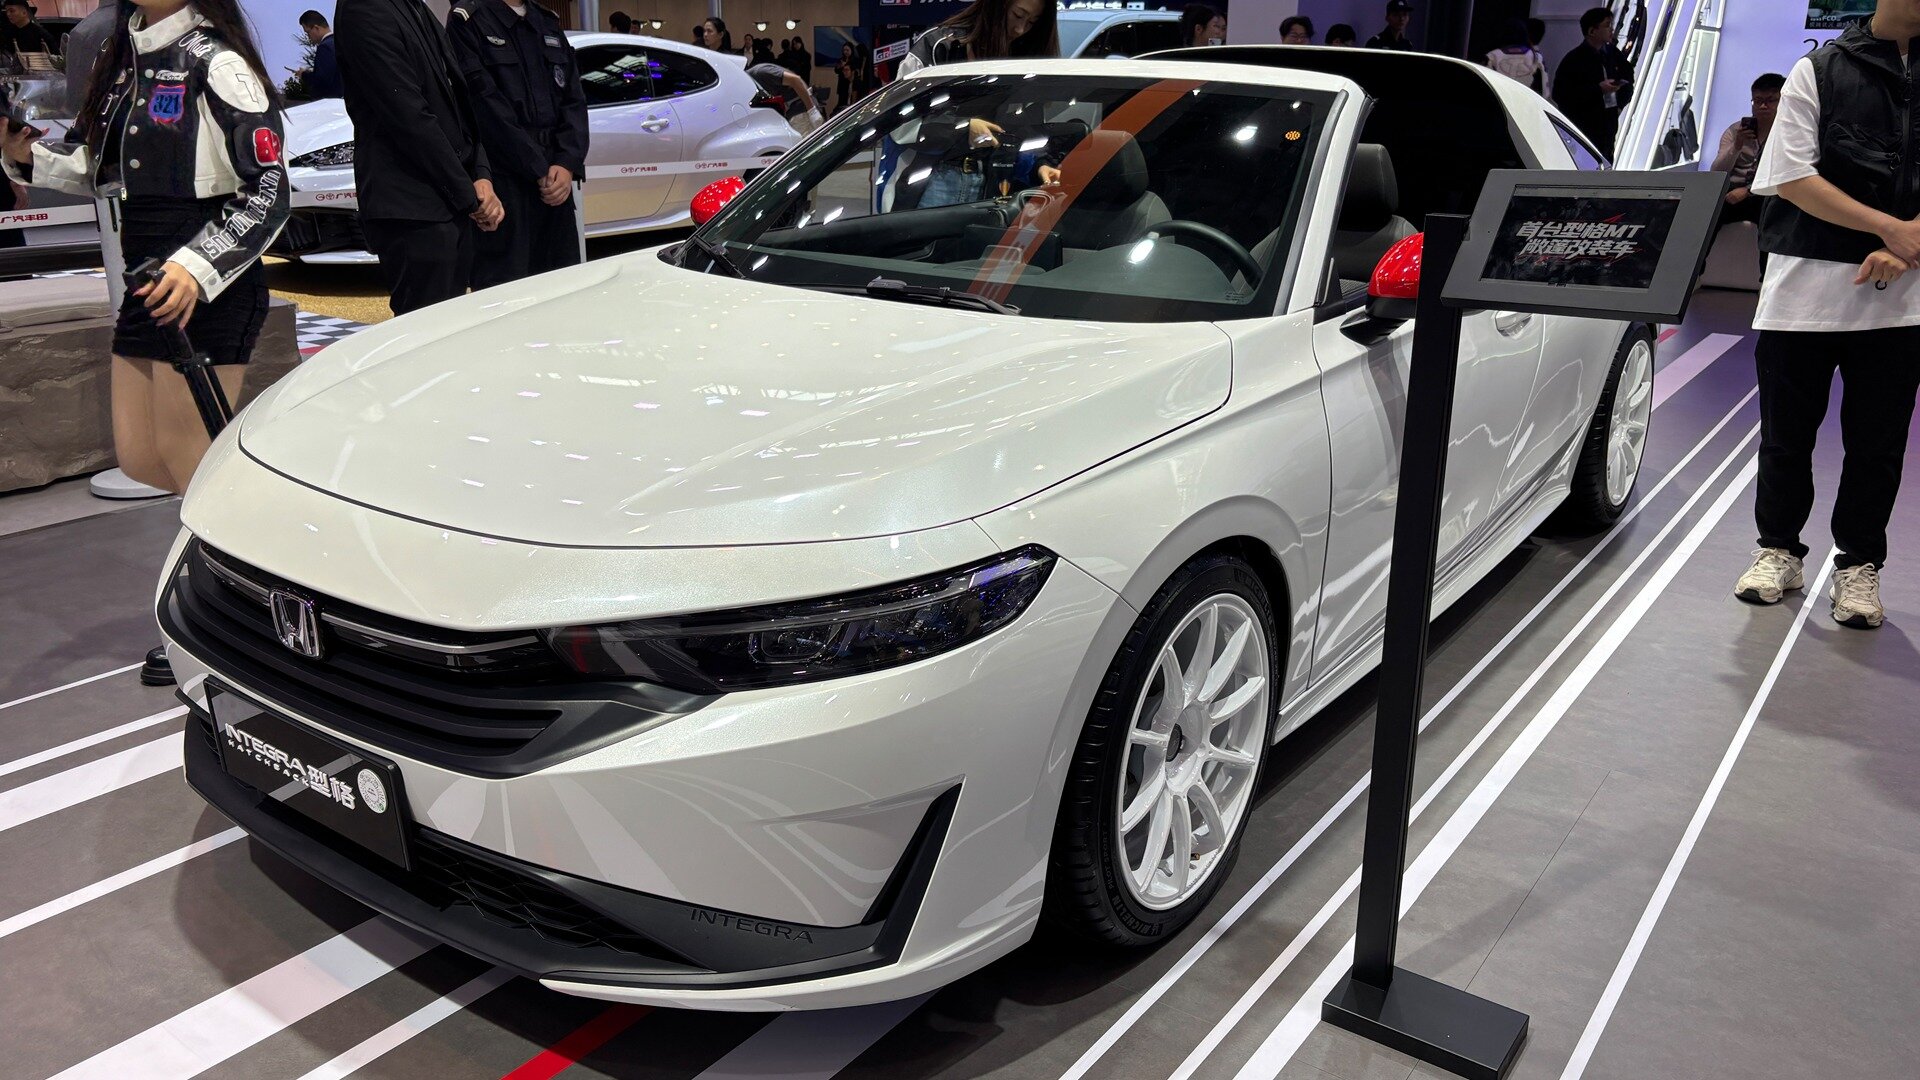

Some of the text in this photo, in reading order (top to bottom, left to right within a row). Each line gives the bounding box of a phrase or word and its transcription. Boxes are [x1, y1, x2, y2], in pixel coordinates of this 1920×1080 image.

[0, 213, 48, 224] 广汽丰田
[1515, 221, 1646, 241] 首台型格MT
[1518, 239, 1638, 260] 敞篷改装车
[224, 722, 356, 811] INTEGRA 型格
[227, 738, 310, 788] HATCHBACK
[690, 908, 814, 944] INTEGRA
